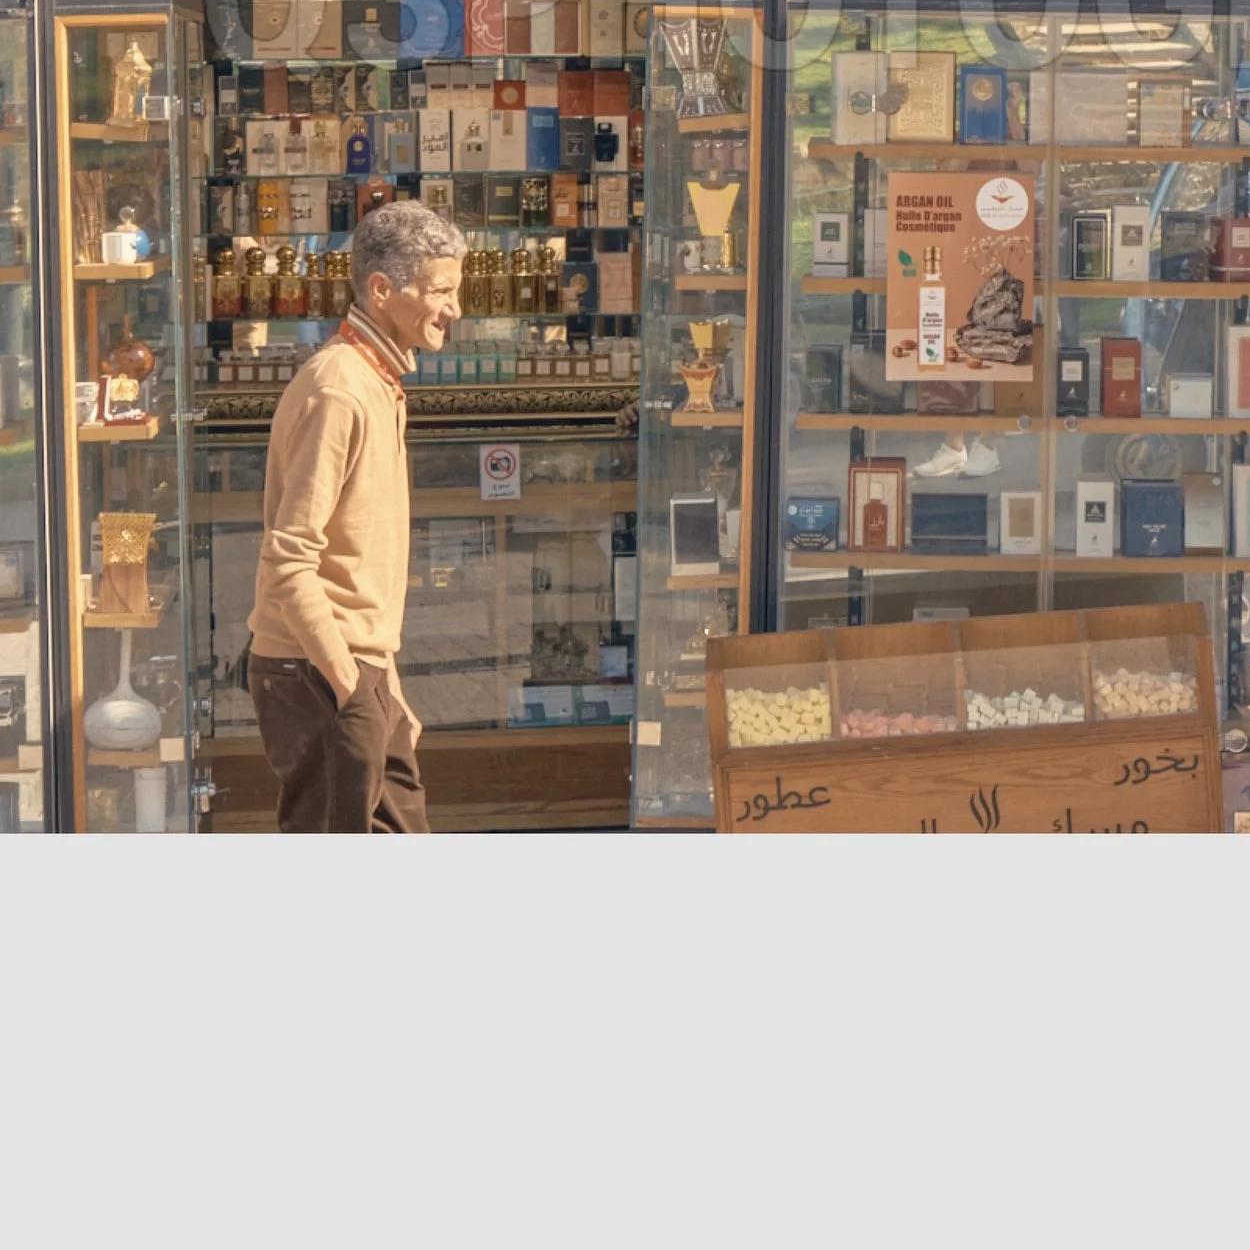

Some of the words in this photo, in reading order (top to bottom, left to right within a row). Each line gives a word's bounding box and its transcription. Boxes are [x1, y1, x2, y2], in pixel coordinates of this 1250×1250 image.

[896, 195, 934, 208] ARGAN
[936, 195, 954, 208] OIL
[896, 210, 922, 221] Huile
[924, 210, 962, 223] D'argan
[1113, 748, 1200, 786] بخور
[735, 776, 831, 822] عطور
